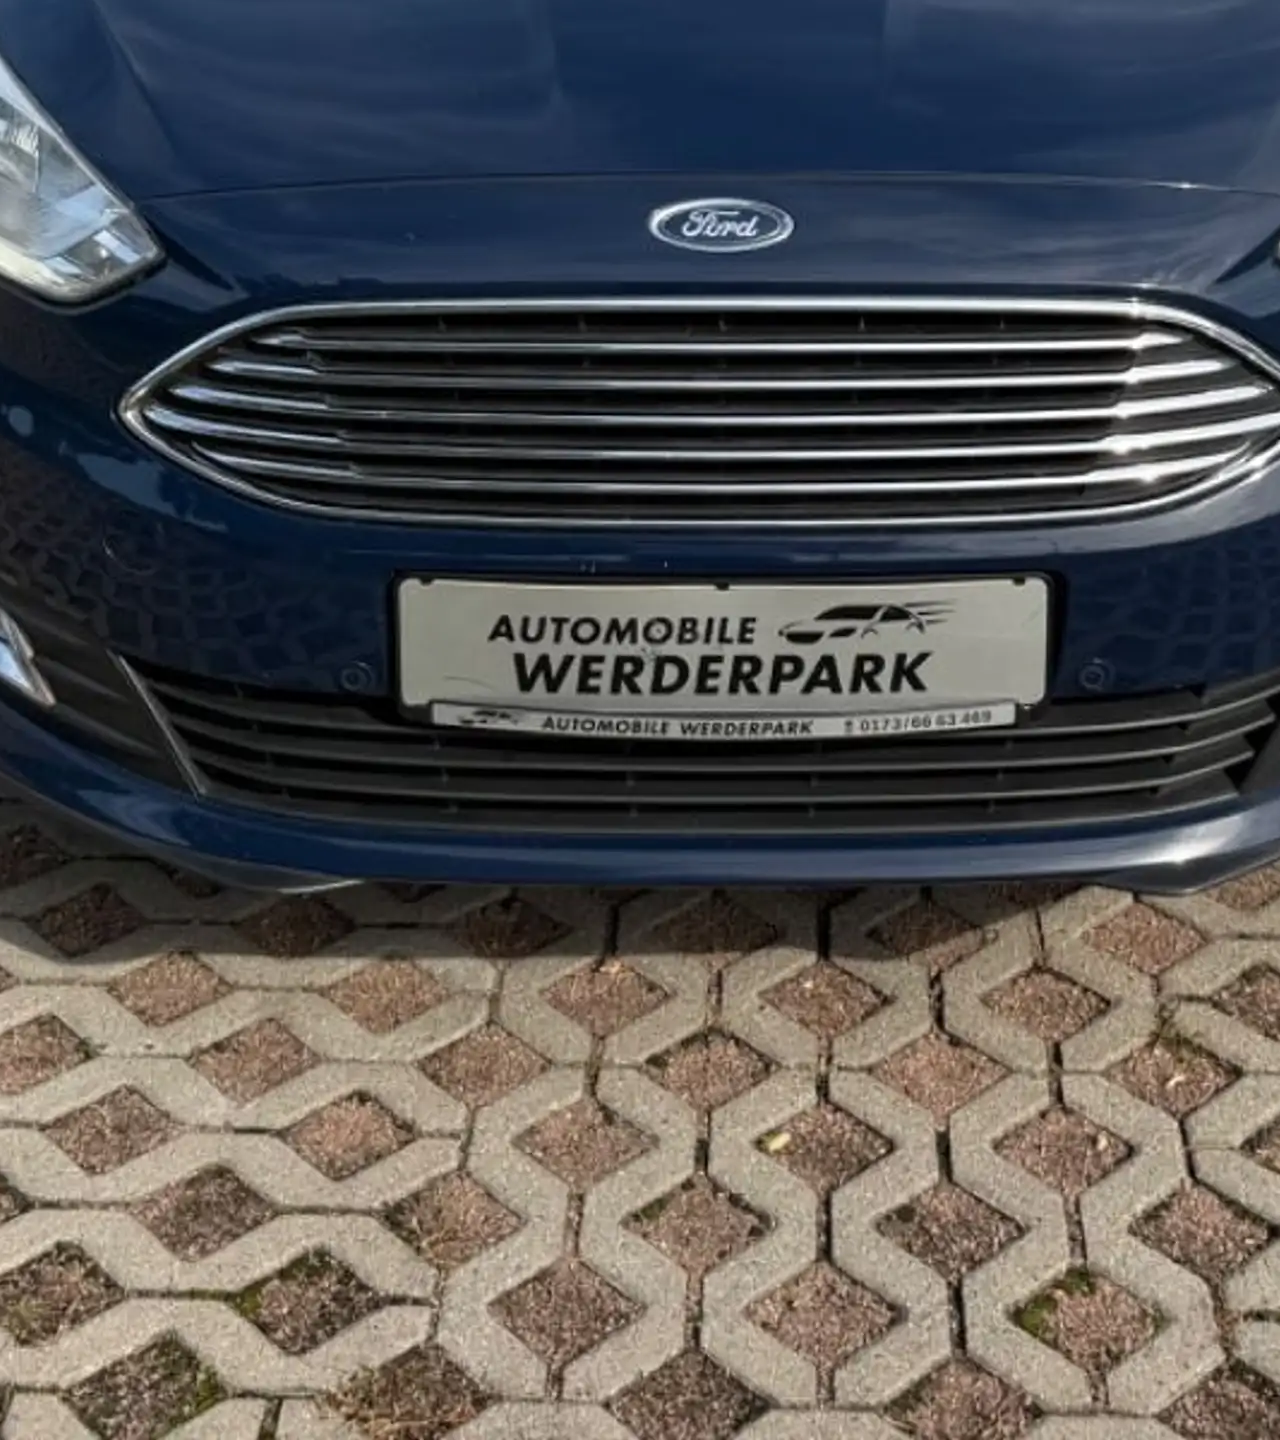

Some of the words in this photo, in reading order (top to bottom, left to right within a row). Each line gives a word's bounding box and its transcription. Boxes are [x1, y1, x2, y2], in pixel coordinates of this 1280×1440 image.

[681, 209, 760, 237] Ford
[487, 614, 758, 645] AUTOMOBILE
[513, 651, 934, 696] WERDERPARK
[542, 716, 670, 735] AUTOMOBILE
[680, 720, 814, 737] WERDERPARK
